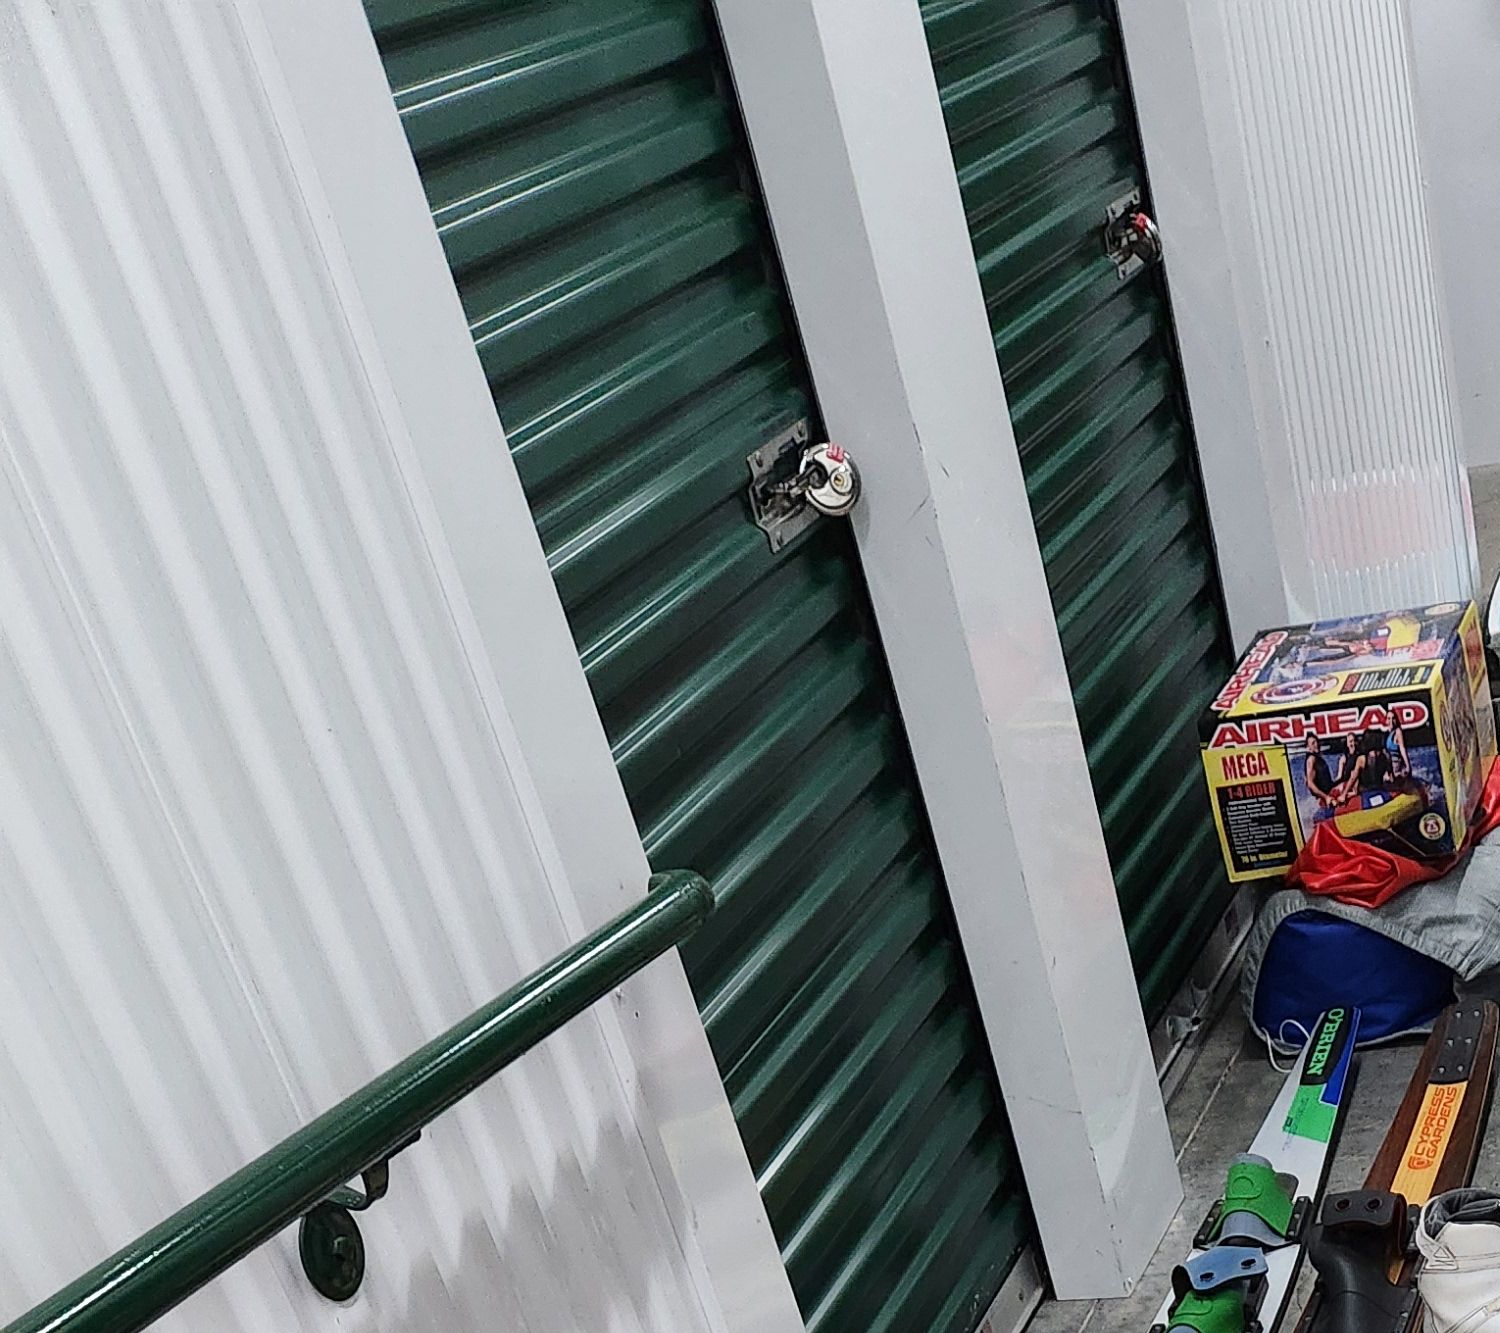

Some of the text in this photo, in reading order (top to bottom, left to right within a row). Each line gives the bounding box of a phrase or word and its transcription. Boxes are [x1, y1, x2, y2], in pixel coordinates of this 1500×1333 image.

[1208, 701, 1429, 749] AIRHEAD
[1221, 751, 1270, 780] MEGA
[1307, 1007, 1346, 1077] O'BRIEN
[1415, 1086, 1446, 1155] CYPRESS
[1425, 1086, 1458, 1159] GARDENS
